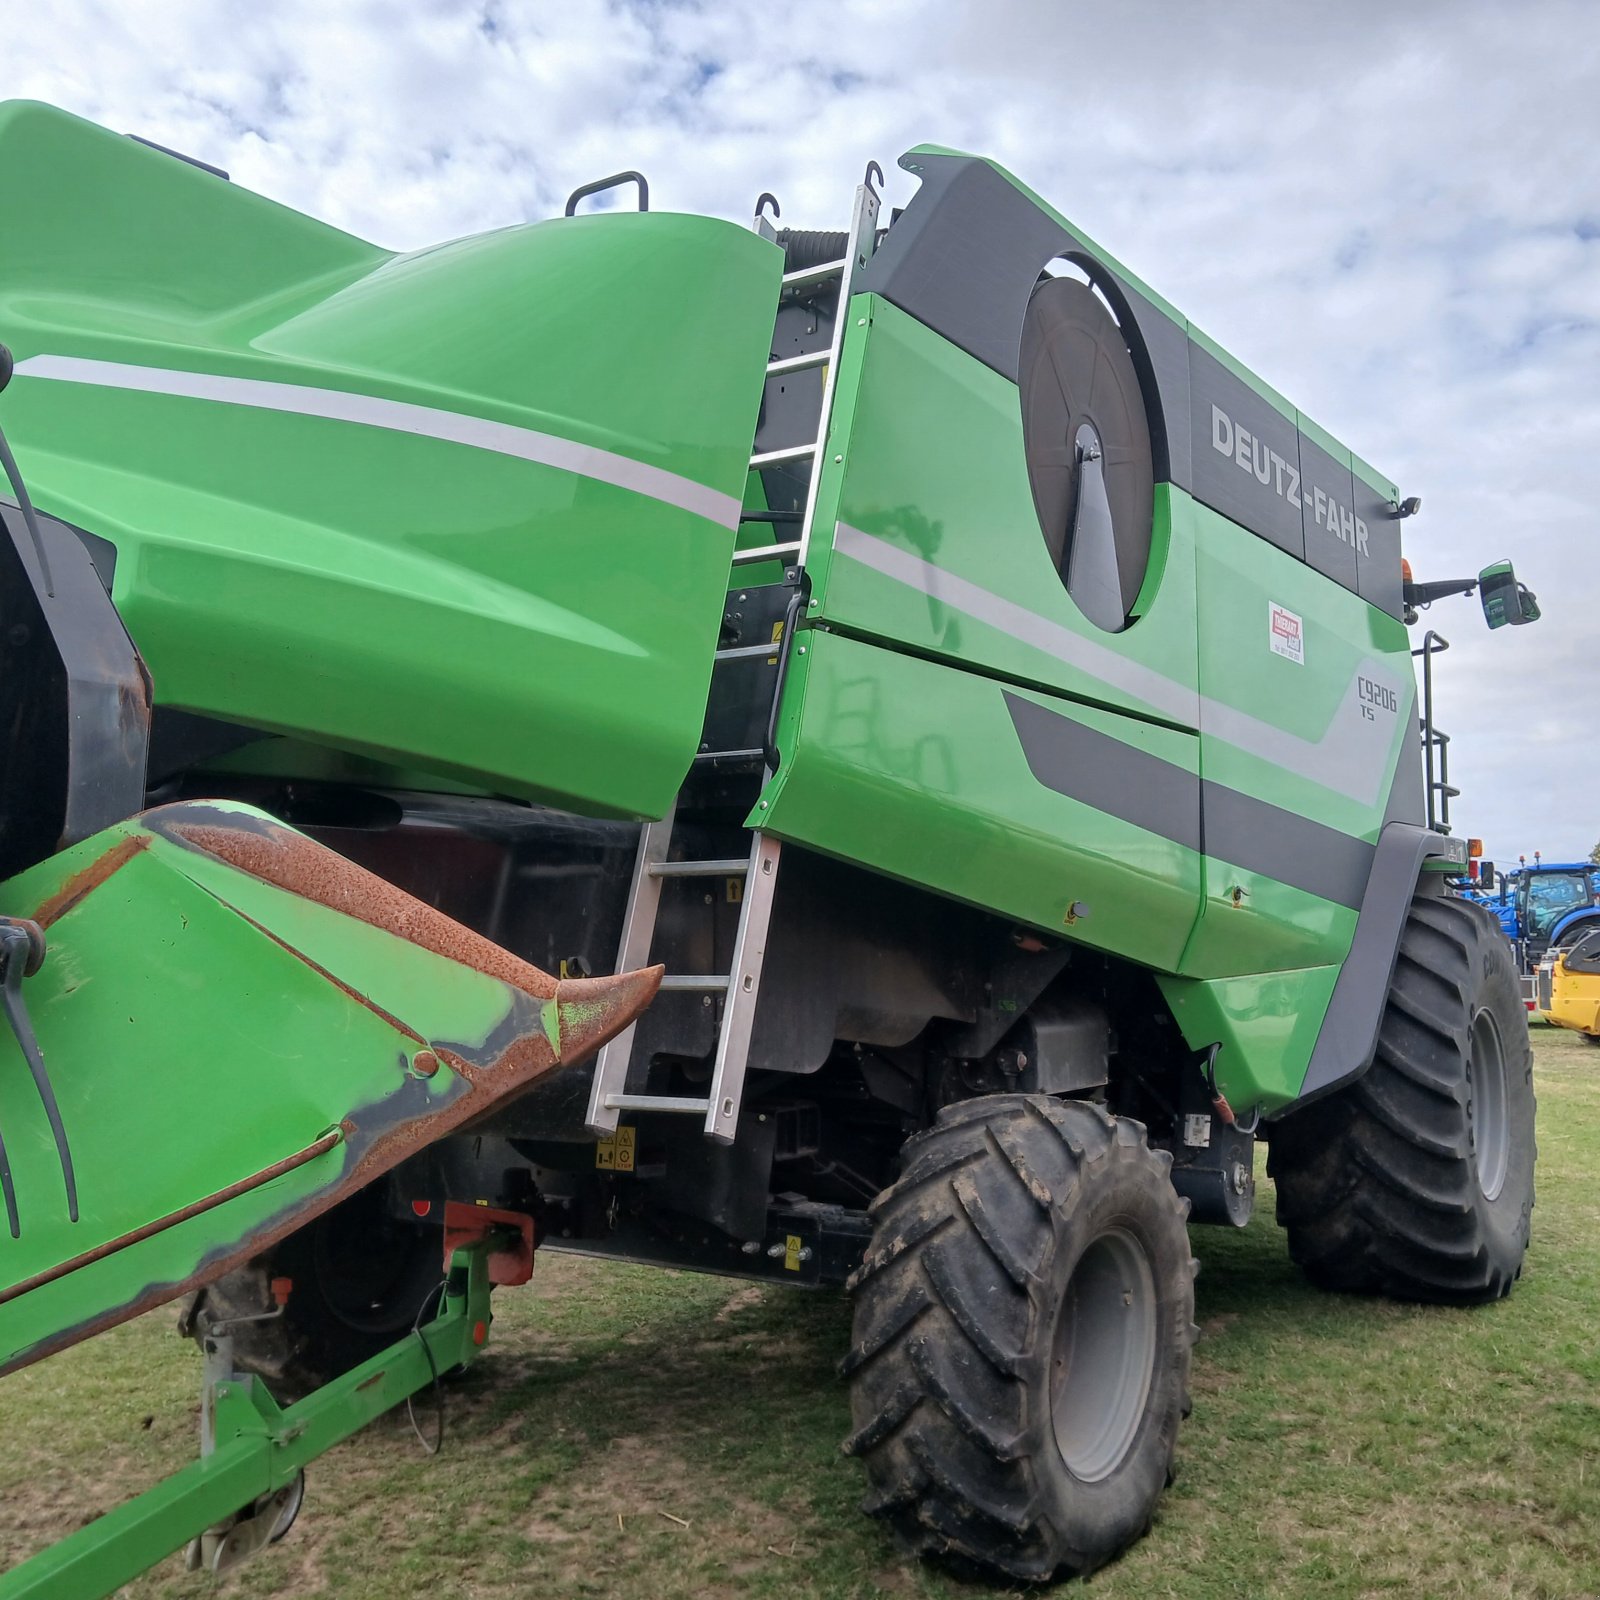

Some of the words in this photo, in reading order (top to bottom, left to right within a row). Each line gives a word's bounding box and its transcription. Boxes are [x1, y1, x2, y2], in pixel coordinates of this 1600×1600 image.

[1212, 403, 1369, 558] DEUTZ-FAHR
[1358, 676, 1397, 713] C9206
[1360, 704, 1375, 721] TS
